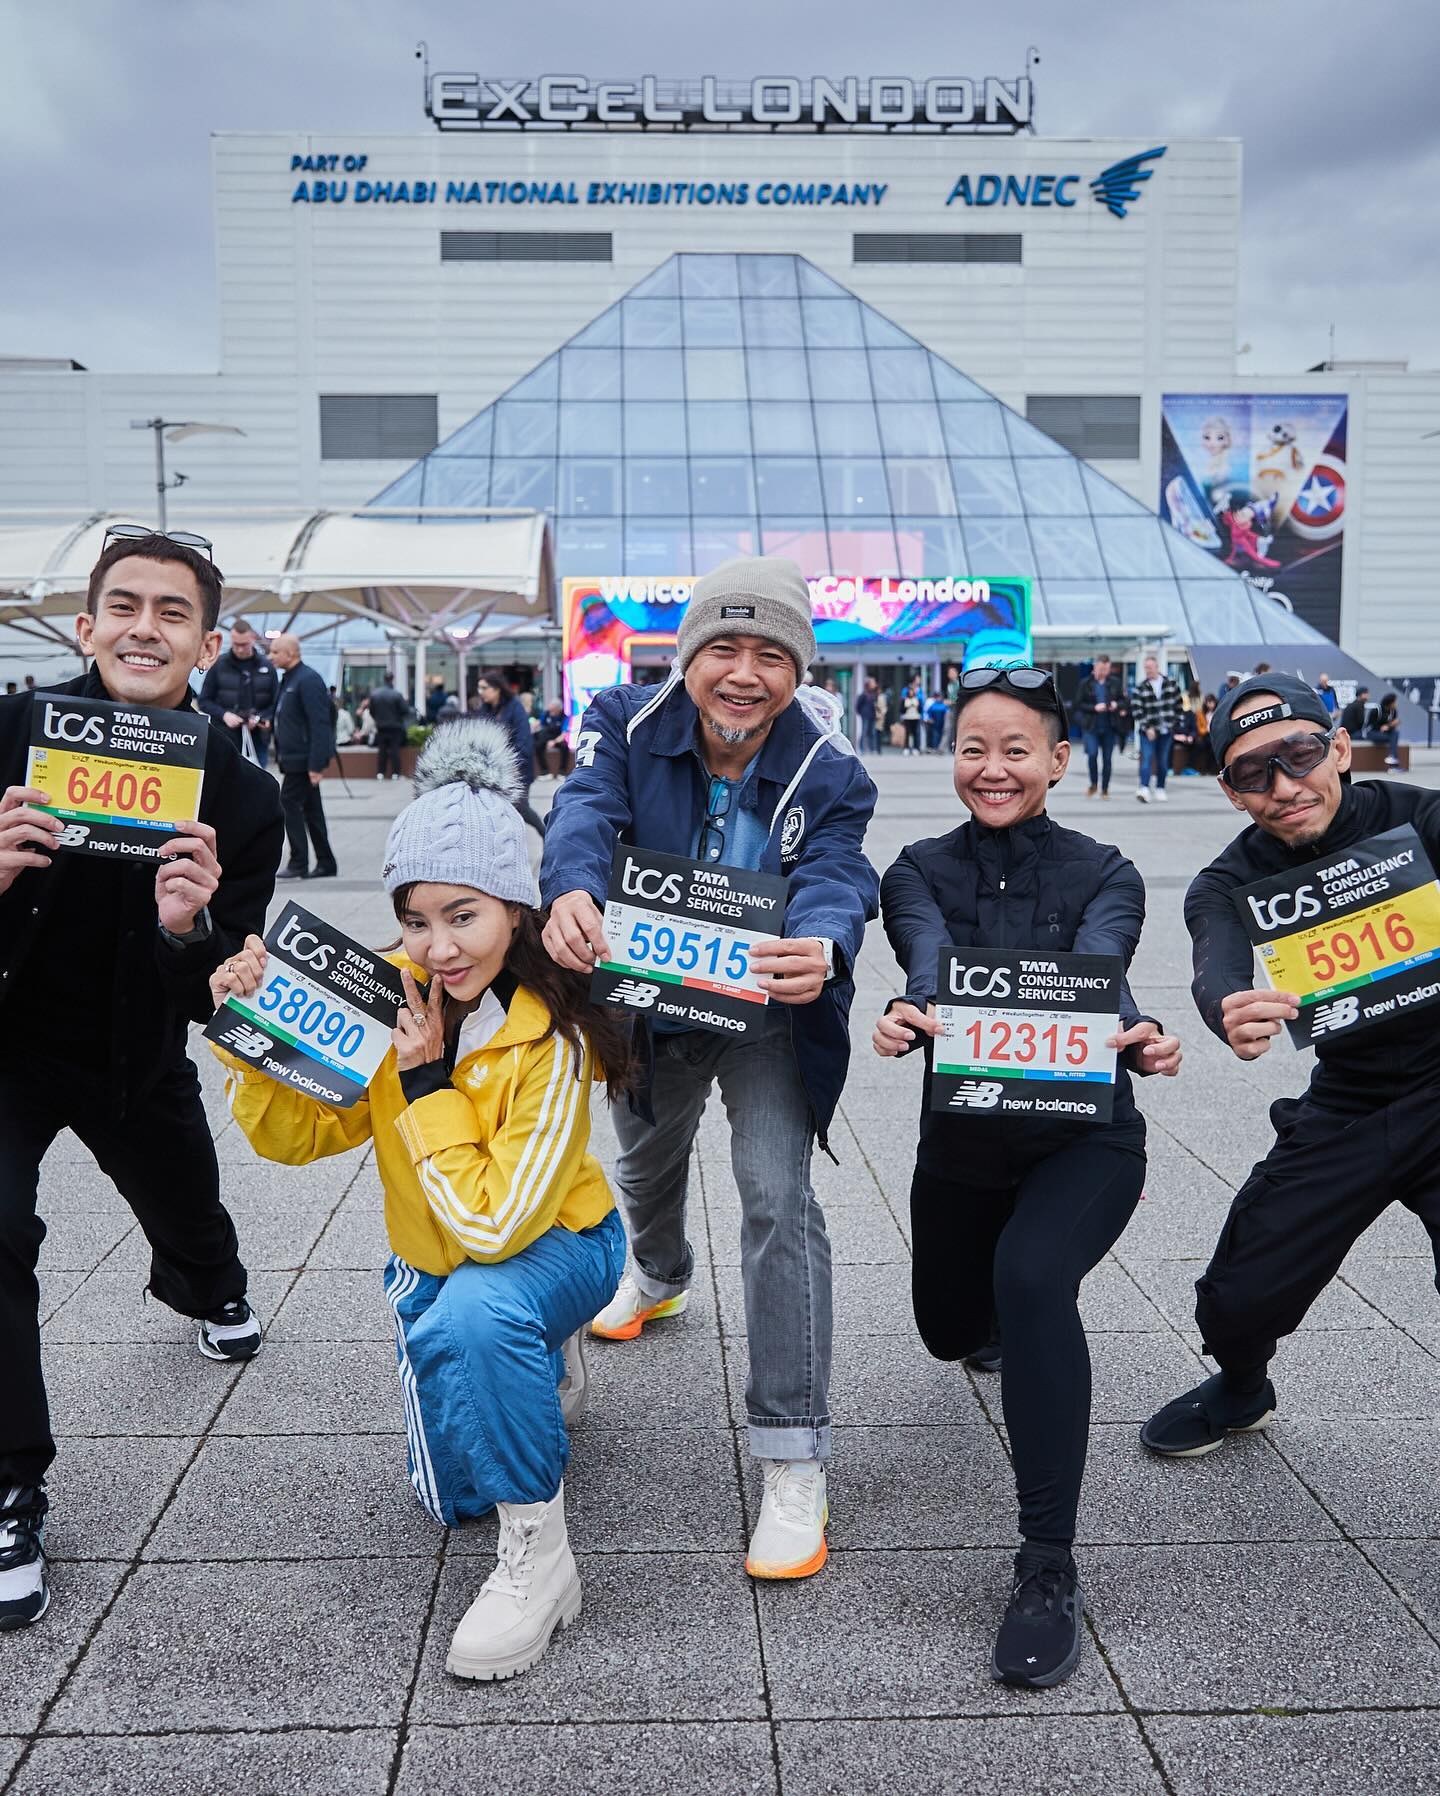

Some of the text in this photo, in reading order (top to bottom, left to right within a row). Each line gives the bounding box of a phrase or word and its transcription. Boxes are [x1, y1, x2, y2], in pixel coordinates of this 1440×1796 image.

[702, 76, 1032, 123] LONDON
[291, 155, 368, 172] PART OF
[293, 181, 888, 206] ABU DHABI NATIONAL EXHIBITIONS COMPANY
[946, 175, 1081, 207] ADNEC
[600, 576, 696, 604] Welco
[880, 576, 991, 603] London
[44, 703, 105, 745] tcs
[113, 711, 150, 727] TATA
[109, 738, 165, 755] SERVICES
[111, 725, 198, 746] CONSULTANCY
[67, 766, 163, 815] 6406
[89, 840, 178, 861] new balane
[622, 856, 683, 904] tcs
[692, 870, 729, 887] TATA
[1316, 858, 1360, 882] TATA
[1322, 850, 1415, 896] CONSULTANCY
[686, 897, 743, 918] SERVICES
[689, 884, 776, 911] CONSULTANCY
[1247, 885, 1322, 931] tcs
[1327, 878, 1390, 909] SERVICES
[277, 914, 336, 971] tcs
[628, 922, 750, 980] 59515
[1306, 913, 1414, 981] 5916
[345, 948, 375, 974] TATA
[1019, 960, 1059, 973] TATA
[328, 970, 376, 1004] SERVICES
[336, 960, 406, 1007] CONSULTANCY
[949, 957, 1011, 998] tcs
[1018, 974, 1111, 990] CONSULTANCY
[1018, 988, 1076, 1002] SERVICES
[1363, 998, 1395, 1019] new
[259, 975, 365, 1058] 58090
[657, 1002, 747, 1032] new balance
[966, 1020, 1088, 1065] 12315
[262, 1056, 343, 1102] new balance
[1002, 1098, 1097, 1115] new balance
